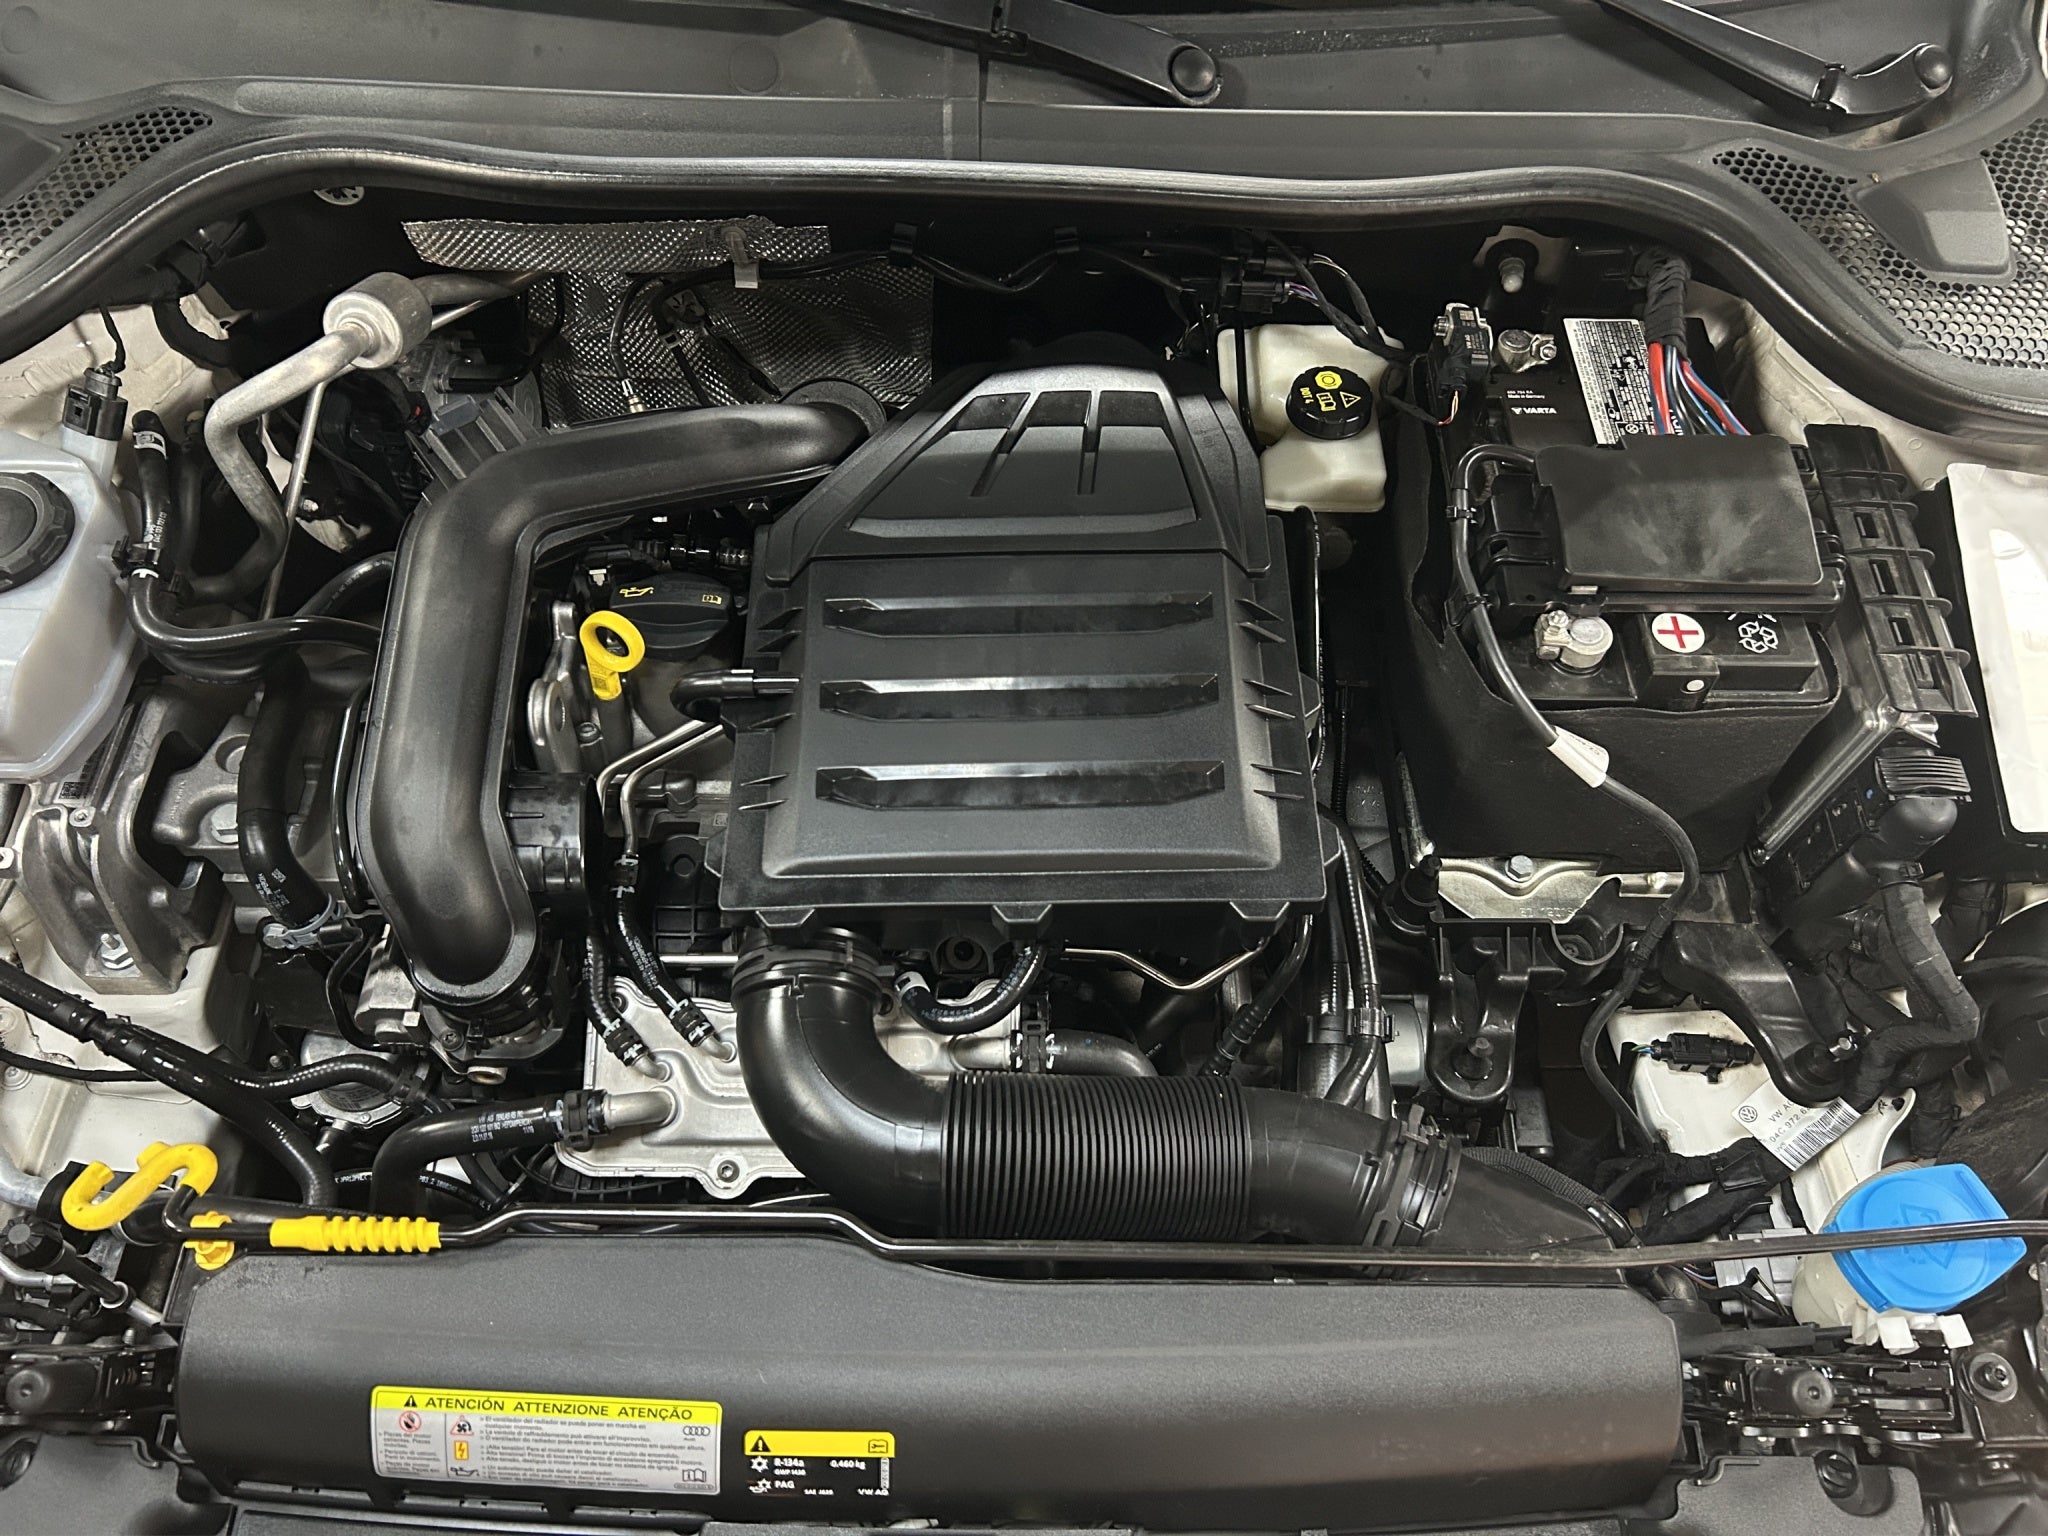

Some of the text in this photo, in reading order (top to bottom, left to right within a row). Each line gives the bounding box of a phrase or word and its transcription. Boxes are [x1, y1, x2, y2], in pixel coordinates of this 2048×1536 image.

[1300, 387, 1313, 398] DOT
[1768, 1109, 1783, 1122] VW
[1784, 1112, 1801, 1128] 972
[425, 1396, 693, 1421] ATENCIÓN ATTENZIONE ATENÇÃO
[773, 1458, 805, 1468] R-134a
[855, 1460, 867, 1470] kg
[774, 1480, 796, 1489] PAG
